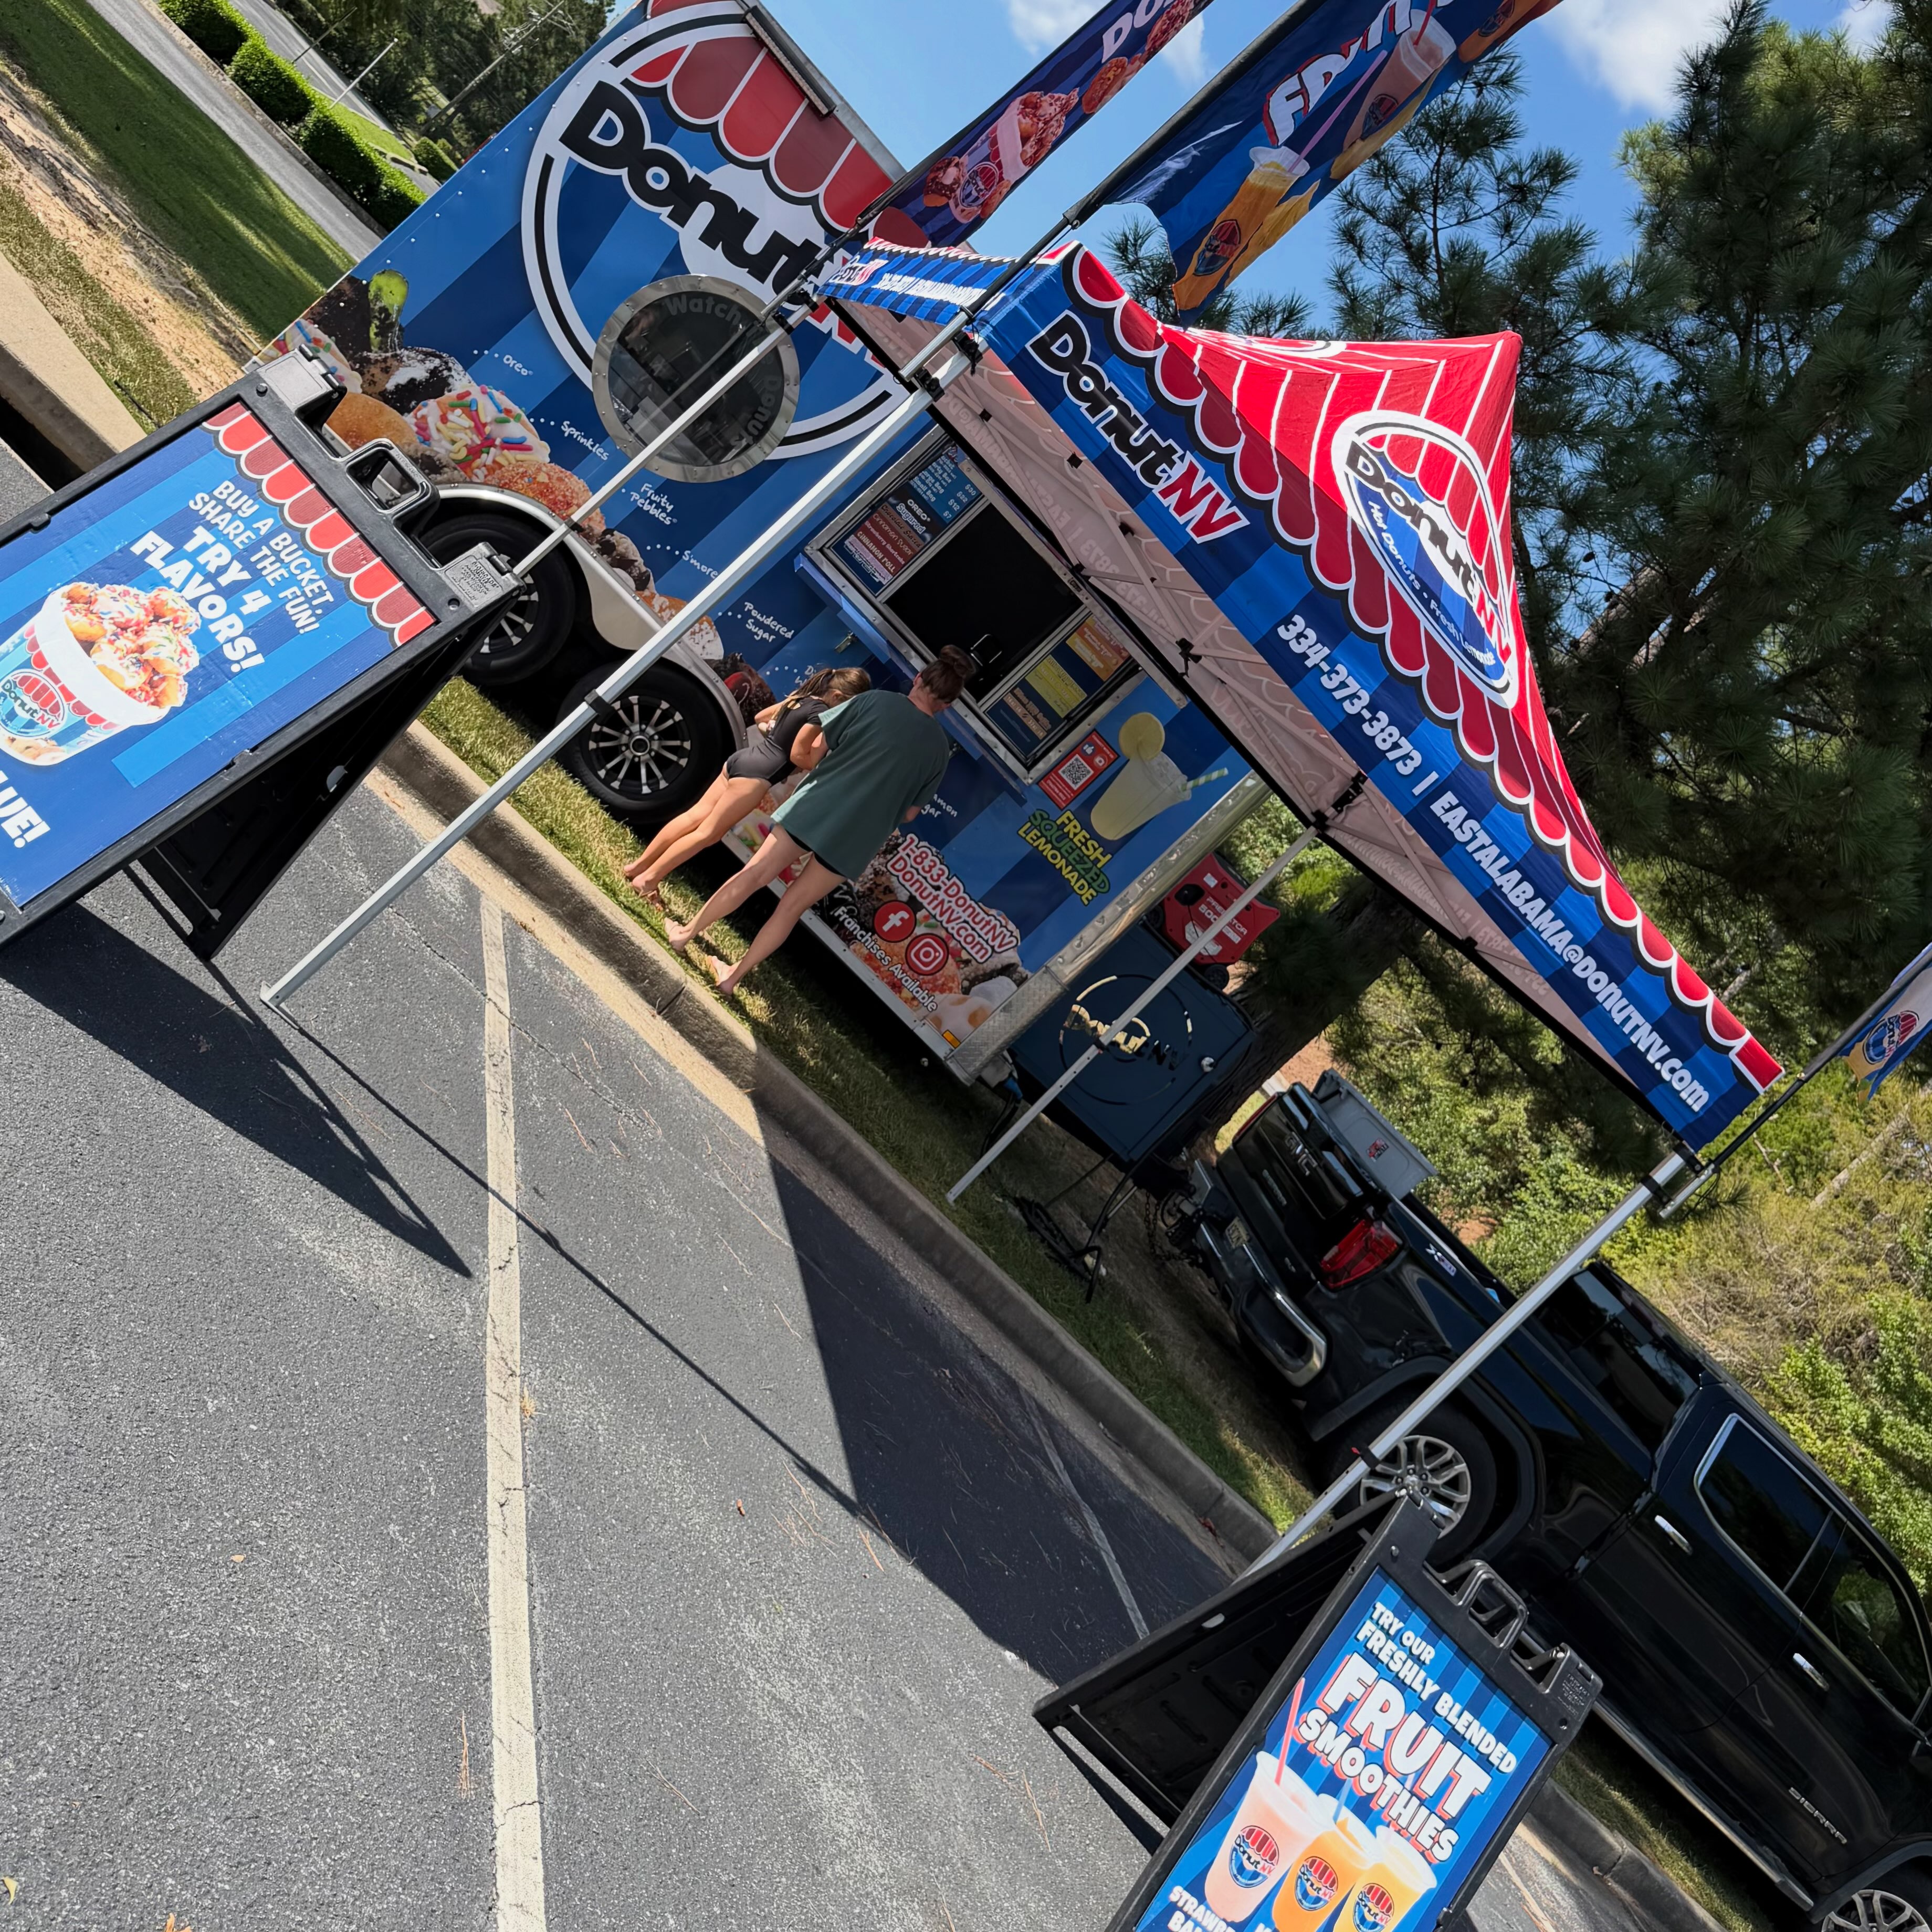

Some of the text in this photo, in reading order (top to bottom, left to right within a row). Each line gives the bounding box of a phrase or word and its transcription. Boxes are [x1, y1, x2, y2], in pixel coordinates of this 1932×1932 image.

[665, 293, 742, 325] Watch
[560, 420, 610, 461] Sprinkles
[1026, 310, 1250, 544] DonutNV
[640, 483, 674, 513] Fruity
[894, 501, 926, 536] Sugared
[183, 526, 272, 616] TRY 4
[189, 492, 319, 636] SHARE THE FUN!
[213, 480, 334, 615] BUY A BUCKET,
[1345, 439, 1512, 665] DonutNV
[1368, 500, 1386, 530] Hot
[1381, 530, 1421, 591] Donuts
[1429, 598, 1461, 640] Fresh
[131, 530, 265, 673] FLAVORS!
[744, 602, 794, 639] Powdered
[746, 620, 776, 643] Sugar
[1277, 614, 1422, 775] 334-373-3873
[0, 770, 50, 848] UE!
[1029, 808, 1110, 894] SQUEEZED
[1056, 810, 1112, 867] FRESH
[899, 834, 1017, 952] 1-833-DonutNV
[1017, 822, 1097, 906] LEMONADE
[887, 854, 992, 963] DonutNV.com
[1206, 896, 1247, 935] PRETOR
[834, 906, 938, 1012] Franchises Available
[1284, 1128, 1319, 1177] GMC
[1372, 1602, 1435, 1667] TRY OUR
[1319, 1652, 1492, 1820] FRUIT
[1357, 1620, 1439, 1702] FRESHLY
[1434, 1693, 1517, 1774] BLENDED
[1296, 1707, 1460, 1864] SMOOTHIES
[1788, 1787, 1847, 1844] SIERRA
